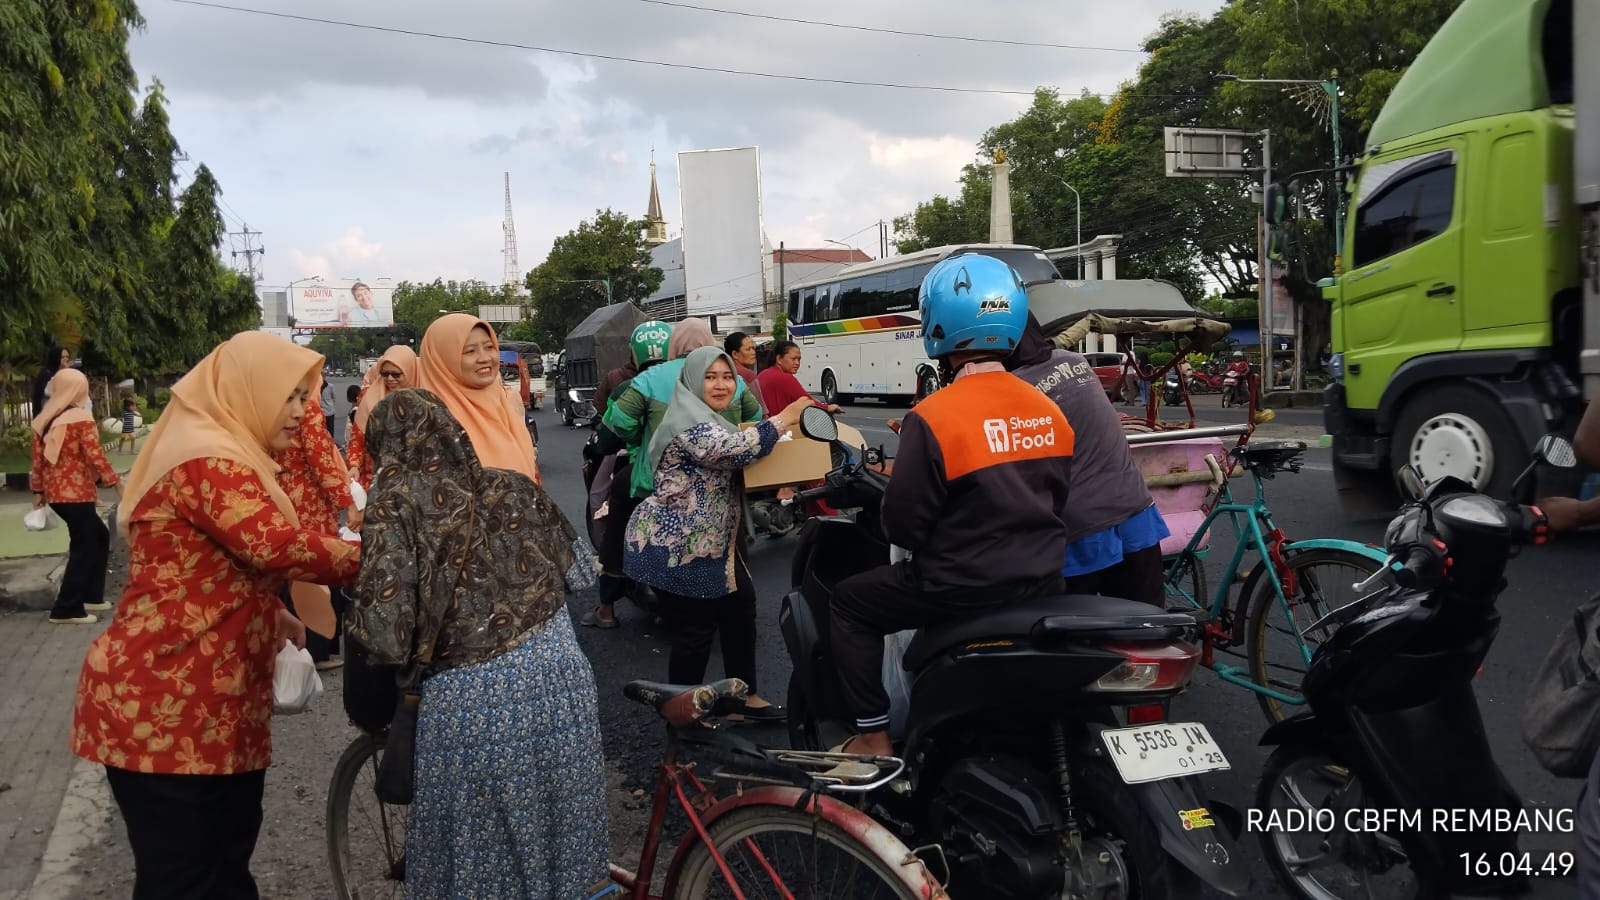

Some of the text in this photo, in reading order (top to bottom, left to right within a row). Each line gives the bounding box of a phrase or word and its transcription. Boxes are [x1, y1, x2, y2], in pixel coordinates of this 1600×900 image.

[977, 296, 1011, 317] INK
[635, 327, 669, 343] Grab
[895, 330, 915, 340] SINAR
[1009, 416, 1053, 430] Shopee
[1012, 427, 1055, 452] Food
[1110, 735, 1127, 755] K
[1133, 729, 1178, 752] 5536
